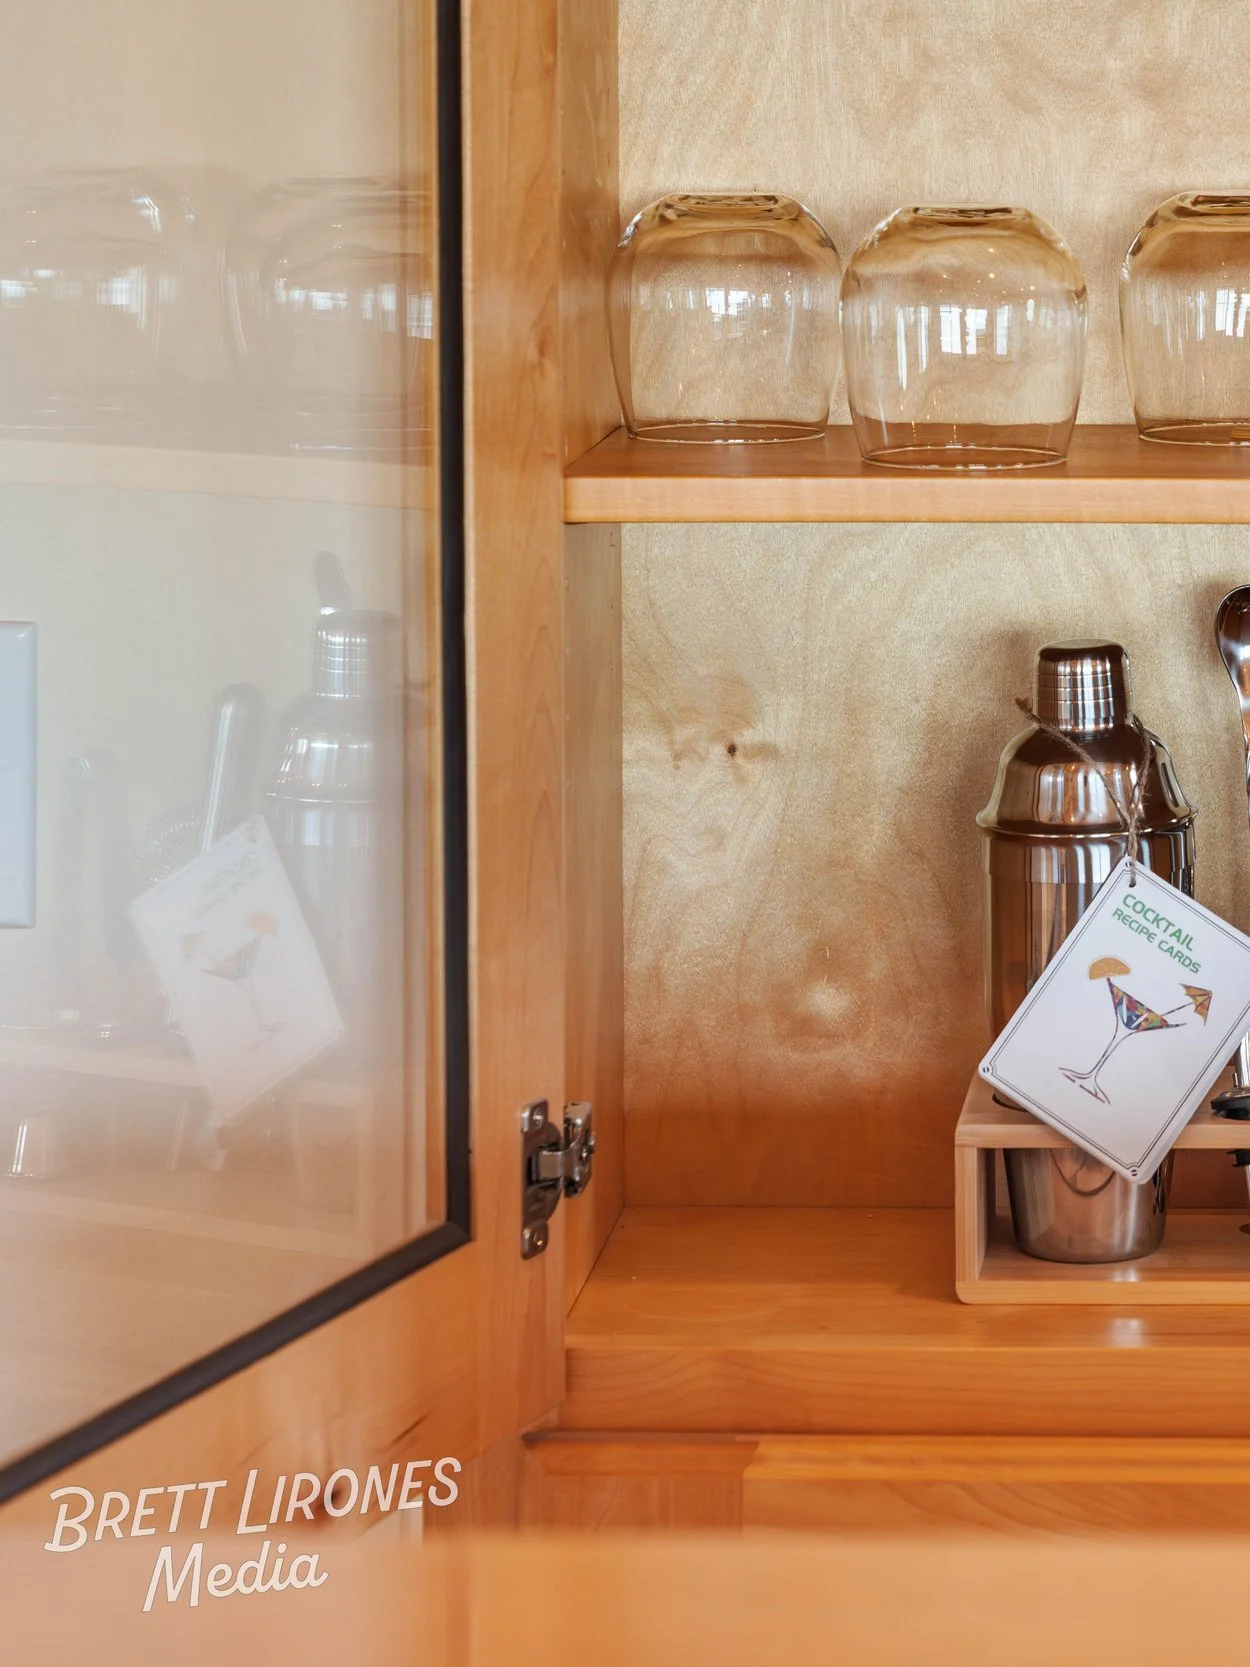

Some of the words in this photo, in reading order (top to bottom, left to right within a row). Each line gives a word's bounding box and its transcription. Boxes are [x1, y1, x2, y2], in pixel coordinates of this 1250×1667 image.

[1112, 907, 1157, 943] RECIPE
[1157, 940, 1202, 974] CARDS
[1122, 894, 1194, 952] COCKTAIL
